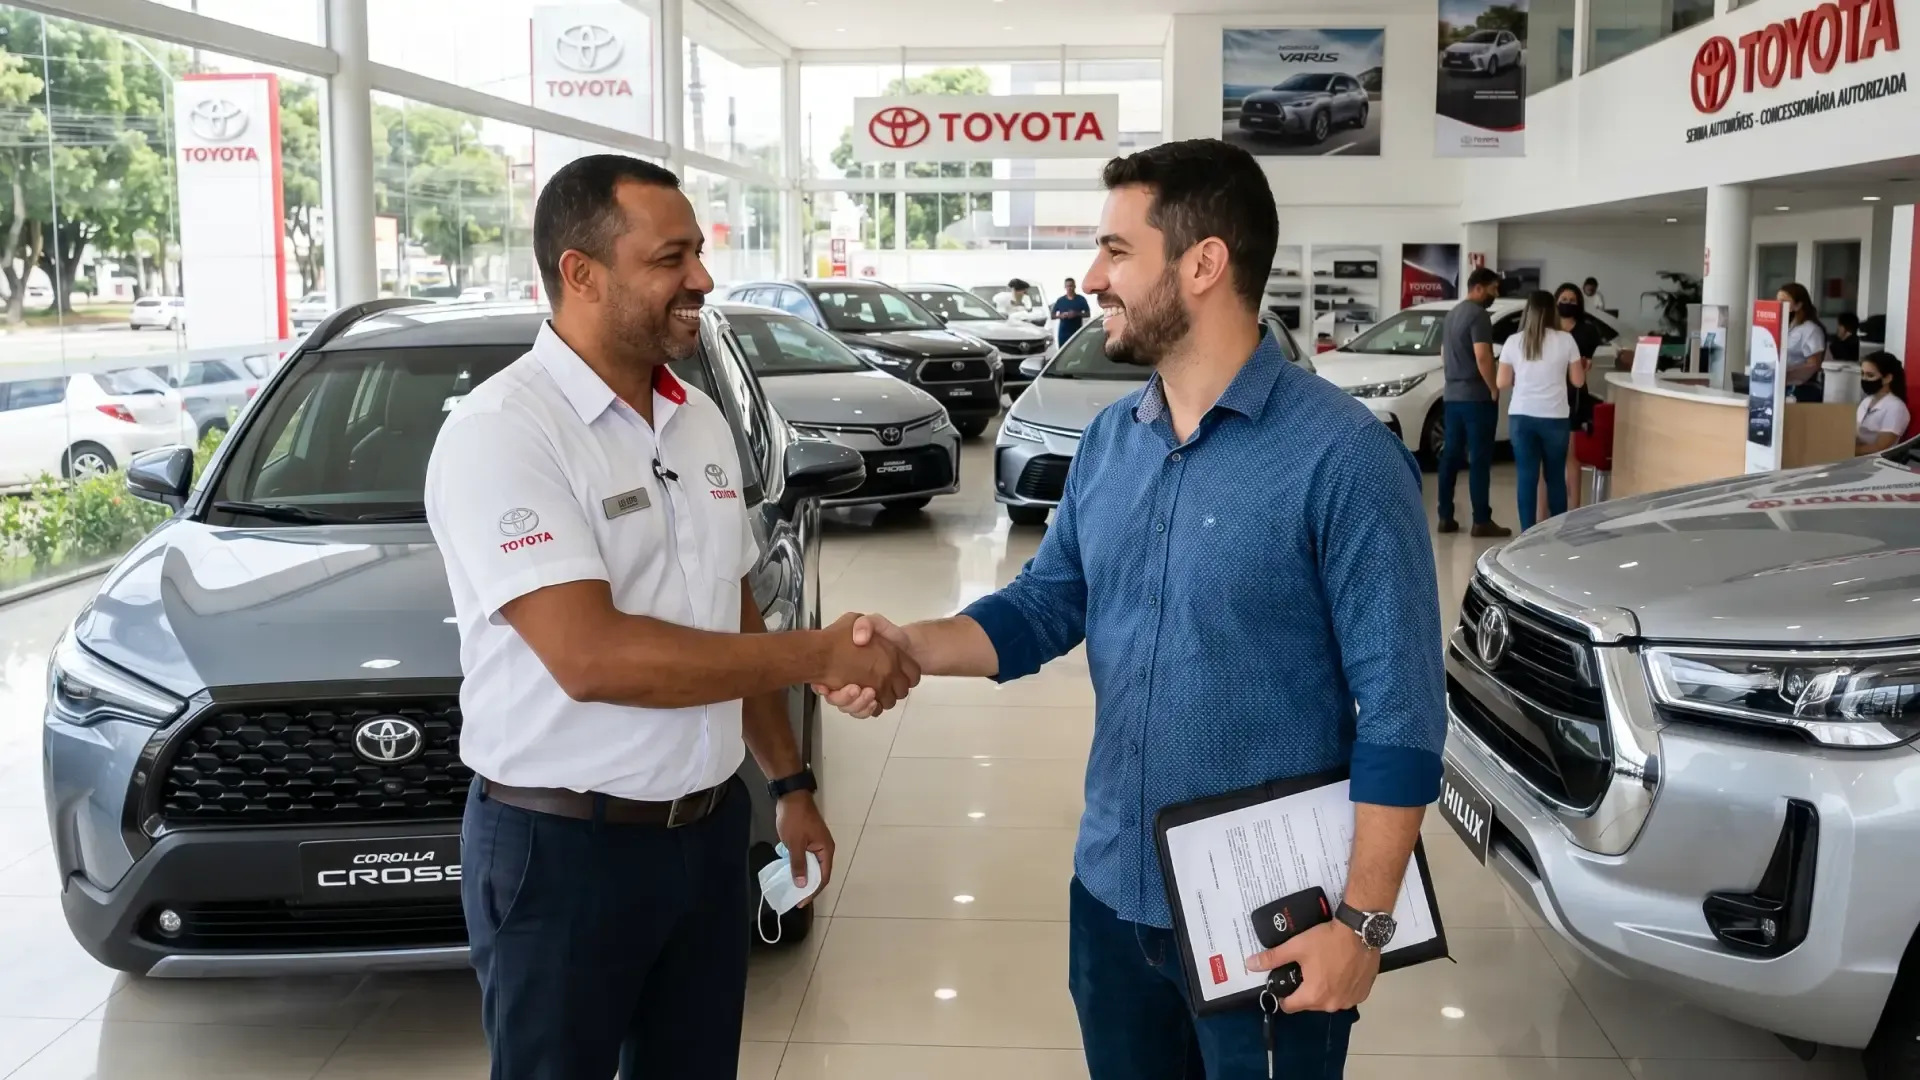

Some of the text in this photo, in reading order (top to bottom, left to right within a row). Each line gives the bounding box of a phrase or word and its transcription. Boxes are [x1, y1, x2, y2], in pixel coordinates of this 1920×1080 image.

[1739, 0, 1900, 93] TOYOTA
[1279, 52, 1340, 63] VARIS
[545, 79, 633, 97] TOYOTA
[1760, 90, 1836, 126] CONCESSIONÁRIA
[1837, 72, 1907, 108] AUTORIZADA
[938, 111, 1104, 142] TOYOTA
[181, 147, 260, 162] TOYOTA
[1409, 283, 1442, 291] TOYOTA
[500, 532, 554, 553] TOYOTA
[1443, 782, 1484, 844] HILUX
[353, 851, 435, 864] COROLLA
[317, 865, 462, 887] CROSS
